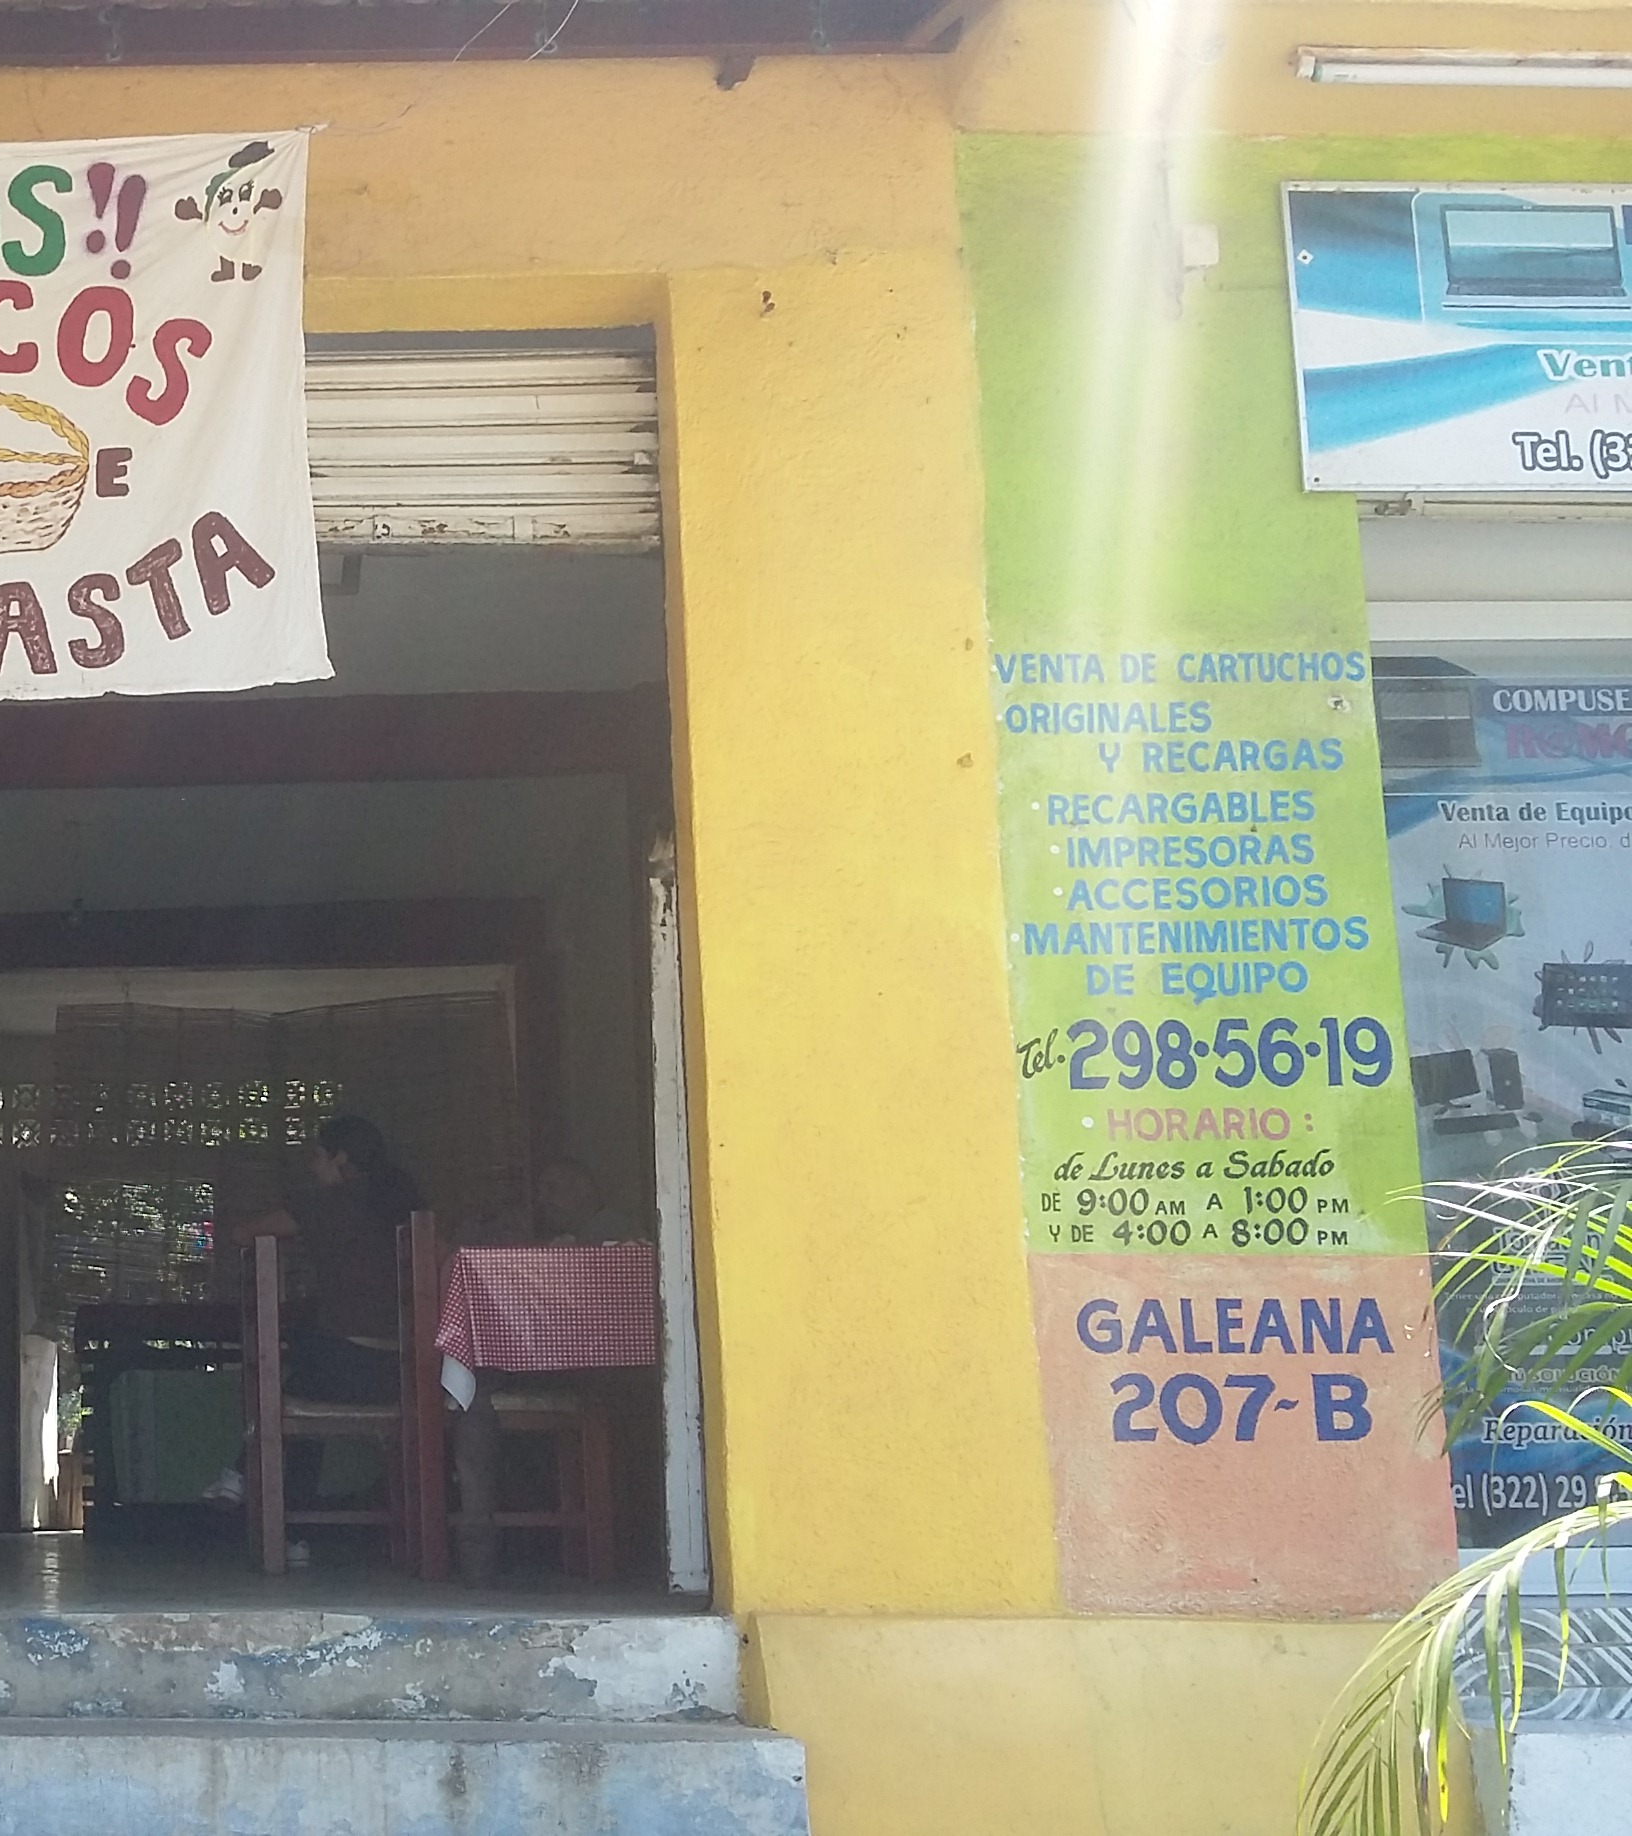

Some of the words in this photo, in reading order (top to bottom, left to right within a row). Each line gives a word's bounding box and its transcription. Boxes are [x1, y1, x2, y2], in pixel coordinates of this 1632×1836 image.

[1512, 430, 1584, 471] Tel.
[1589, 429, 1632, 479] (3
[994, 653, 1105, 684] VENTA
[1120, 653, 1156, 683] DE
[1176, 651, 1367, 683] CARTUCHOS
[1004, 701, 1213, 733] ORIGINALES
[1493, 688, 1632, 712] COMPUSE
[1098, 742, 1121, 773] Y
[1143, 738, 1344, 773] RECARGAS
[1047, 790, 1316, 826] RECARGABLES
[1441, 802, 1510, 822] Venta
[1519, 802, 1547, 821] de
[1067, 833, 1315, 869] IMPRESORAS
[1459, 833, 1477, 849] Al
[1485, 833, 1539, 852] Mejor
[1066, 874, 1329, 911] ACCESORIOS
[1024, 916, 1370, 956] MANTENIMIENTOS
[1086, 964, 1134, 995] DE
[1161, 961, 1309, 1005] EQUIPO
[1016, 1028, 1066, 1079] Tel.
[1054, 1152, 1085, 1181] de
[1088, 1151, 1185, 1182] Lunes
[1196, 1160, 1214, 1178] a
[1224, 1149, 1336, 1180] Sabado
[1041, 1192, 1061, 1212] DE
[1076, 1188, 1150, 1216] 9:00
[1155, 1200, 1186, 1215] AM
[1206, 1193, 1223, 1210] A
[1243, 1186, 1309, 1214] 1:00
[1317, 1199, 1349, 1214] PM
[1049, 1224, 1061, 1243] Y
[1071, 1224, 1094, 1243] DE
[1112, 1219, 1191, 1247] 4:00
[1202, 1223, 1218, 1239] A
[1232, 1218, 1310, 1248] 8:00
[1317, 1230, 1349, 1246] PM
[1076, 1297, 1395, 1355] GALEANA
[1483, 1417, 1632, 1448] Reparaión
[1482, 1473, 1548, 1517] (322)
